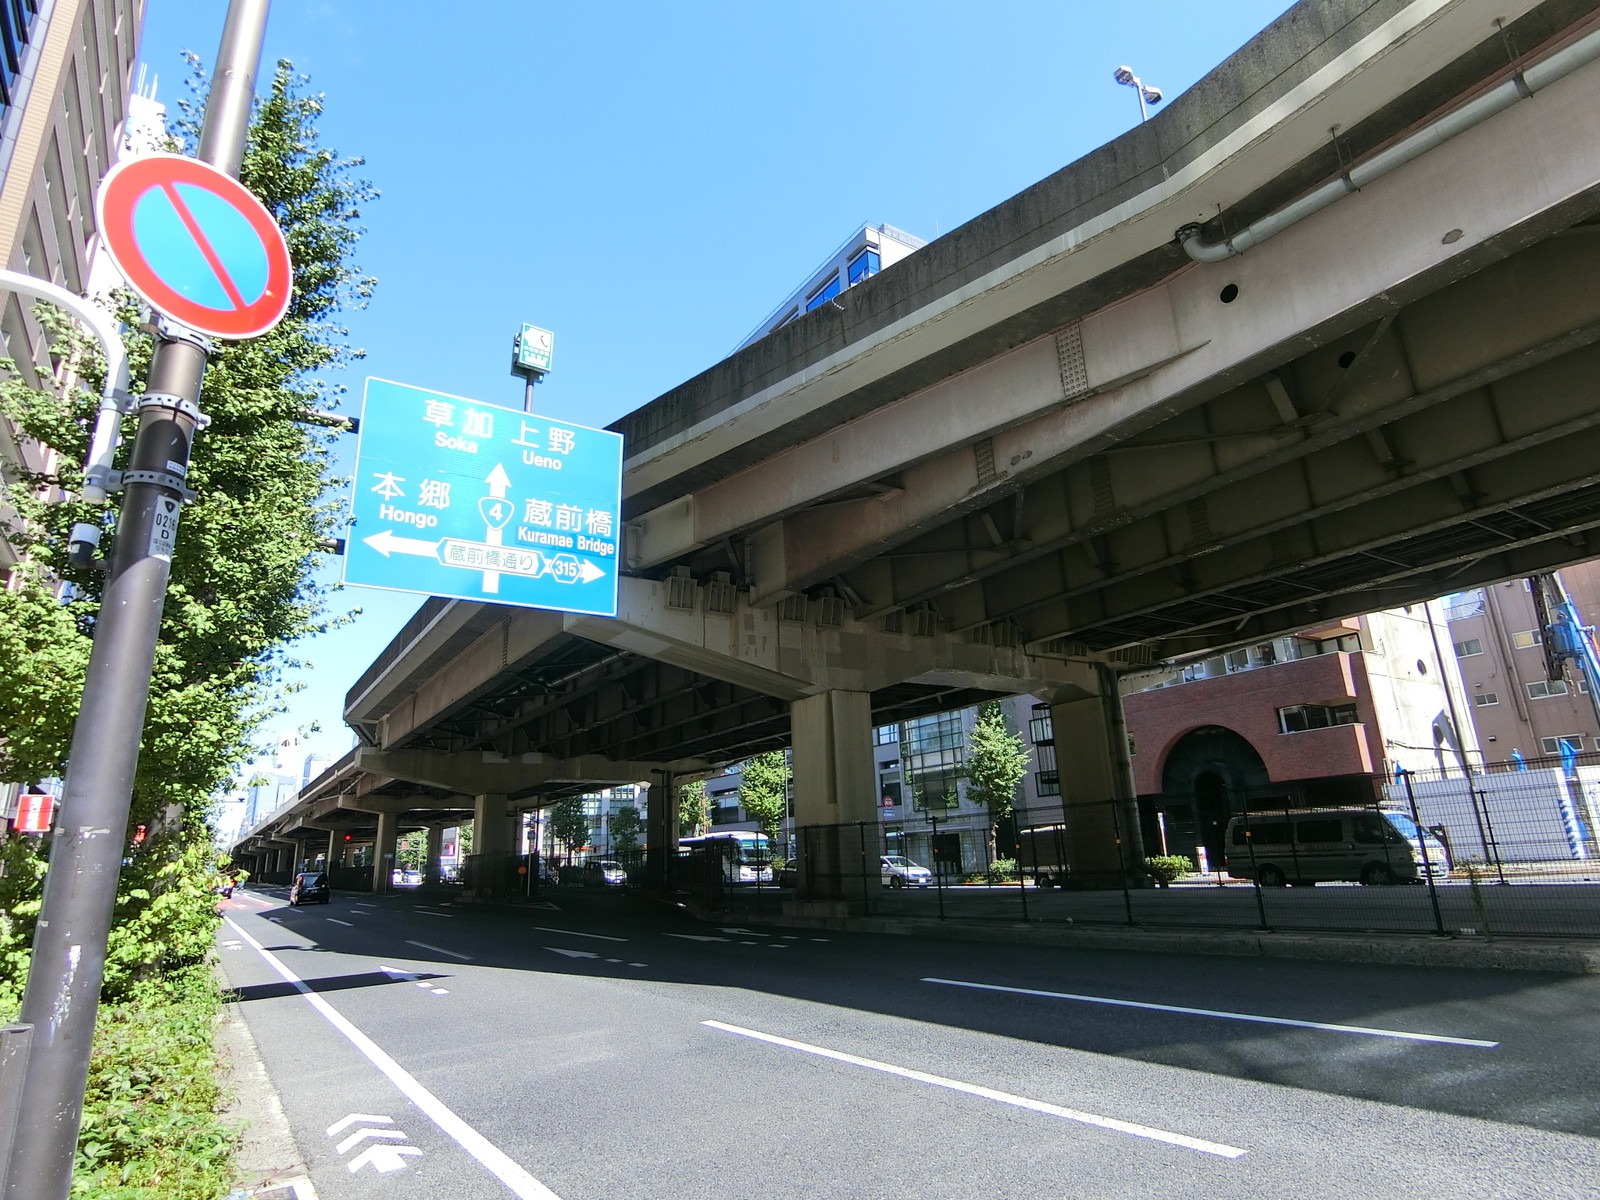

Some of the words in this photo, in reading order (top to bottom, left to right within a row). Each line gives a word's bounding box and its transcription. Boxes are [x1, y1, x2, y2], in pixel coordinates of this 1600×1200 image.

[423, 398, 494, 439] 草加
[434, 431, 478, 453] Soka
[510, 419, 576, 455] 上野
[522, 449, 562, 470] Ueno
[370, 471, 451, 510] 本郷
[156, 513, 176, 531] 0216
[379, 504, 438, 528] Hongo
[489, 503, 503, 521] 4
[523, 498, 613, 537] 蔵前橋
[161, 529, 170, 540] D
[518, 526, 573, 548] Kuramae
[577, 534, 615, 555] Bridge
[448, 544, 533, 571] 蔵前橋通り
[554, 560, 577, 577] 315
